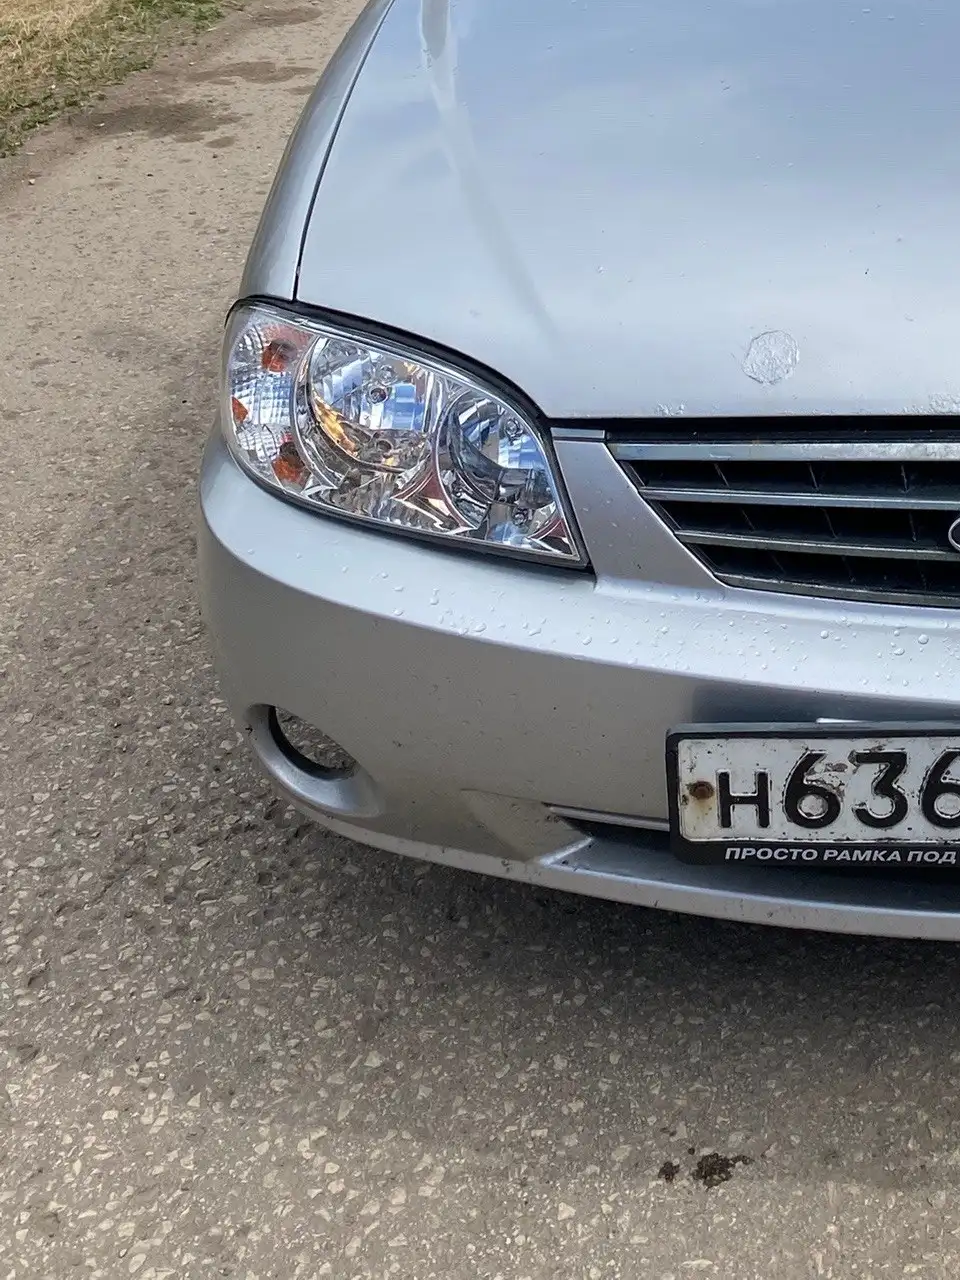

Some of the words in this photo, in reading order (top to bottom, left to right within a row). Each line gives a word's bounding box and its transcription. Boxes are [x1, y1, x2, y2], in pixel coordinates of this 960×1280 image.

[725, 847, 818, 861] ПРОСТО
[823, 849, 901, 862] РАМКА
[907, 850, 957, 865] ПОД
